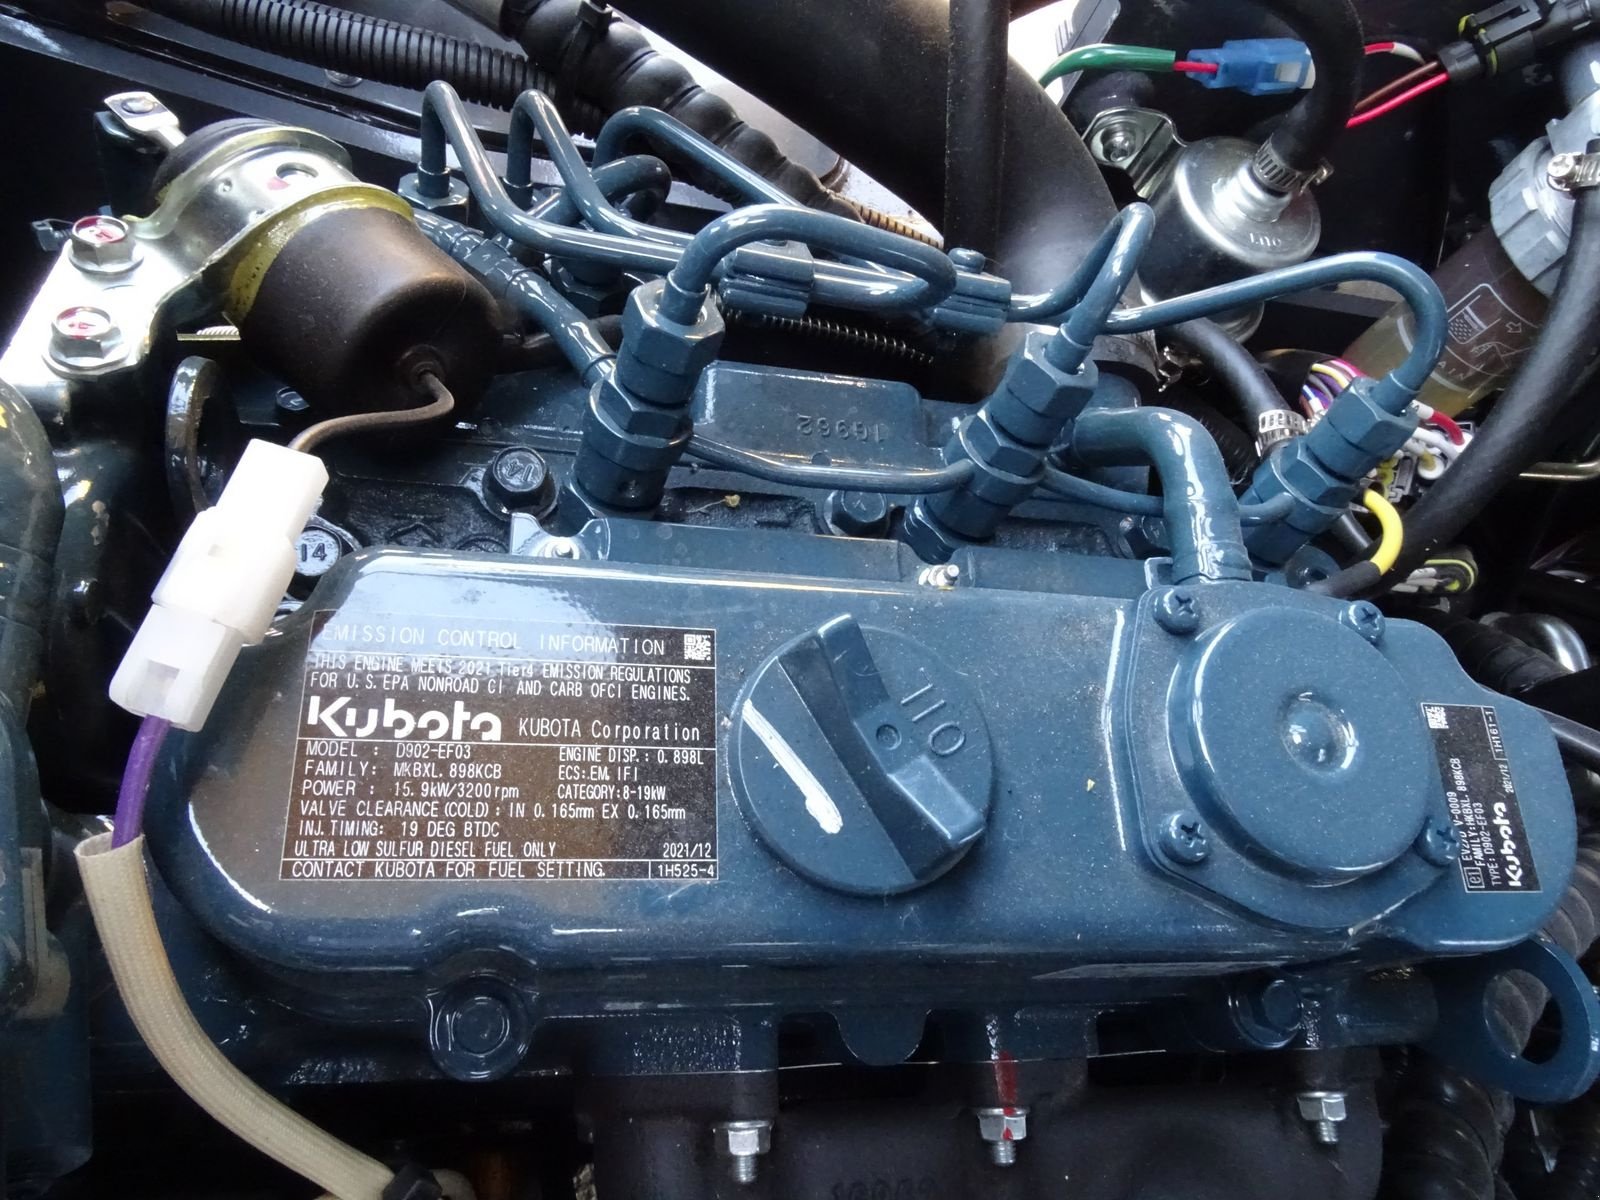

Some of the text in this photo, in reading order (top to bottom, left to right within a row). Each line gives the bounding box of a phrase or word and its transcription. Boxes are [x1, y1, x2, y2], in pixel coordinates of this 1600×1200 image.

[301, 543, 328, 562] 14
[322, 623, 665, 656] EMISSION CONTROL INFORMATION
[314, 653, 691, 684] THIS ENGINE MEETS 2021 Tier4 EMISSION REGULATIONS
[310, 671, 337, 688] FOR
[418, 676, 479, 693] NONROAD
[488, 679, 502, 694] CI
[516, 680, 542, 696] AND
[550, 681, 583, 697] CARB
[591, 682, 622, 699] OFCI
[631, 684, 690, 701] ENGINES.
[307, 695, 501, 741] Kubota
[519, 717, 700, 743] KUBOTA Corporation
[306, 740, 358, 756] MODEL
[396, 742, 471, 759] D902-EF03
[559, 747, 601, 762] ENGINE
[304, 759, 377, 777] FAMILY:
[302, 779, 356, 796] POWER
[1498, 764, 1514, 793] 2021/12
[300, 799, 347, 817] VALVE
[356, 800, 439, 817] CLEARANCE
[509, 802, 526, 818] IN
[602, 803, 619, 819] EX
[401, 821, 418, 837] 19
[427, 821, 456, 837] DEG
[463, 822, 500, 838] BTDC
[1472, 802, 1496, 855] D902-EF03
[294, 840, 556, 858] ULTRA LOW SULFUR DIESEL FUEL ONLY
[662, 842, 712, 860] 2021/12
[1492, 802, 1523, 887] Kubota
[292, 861, 606, 878] CONTACT KUBOTA FOR FUEL SETTING.
[657, 863, 715, 878] 1H525-4
